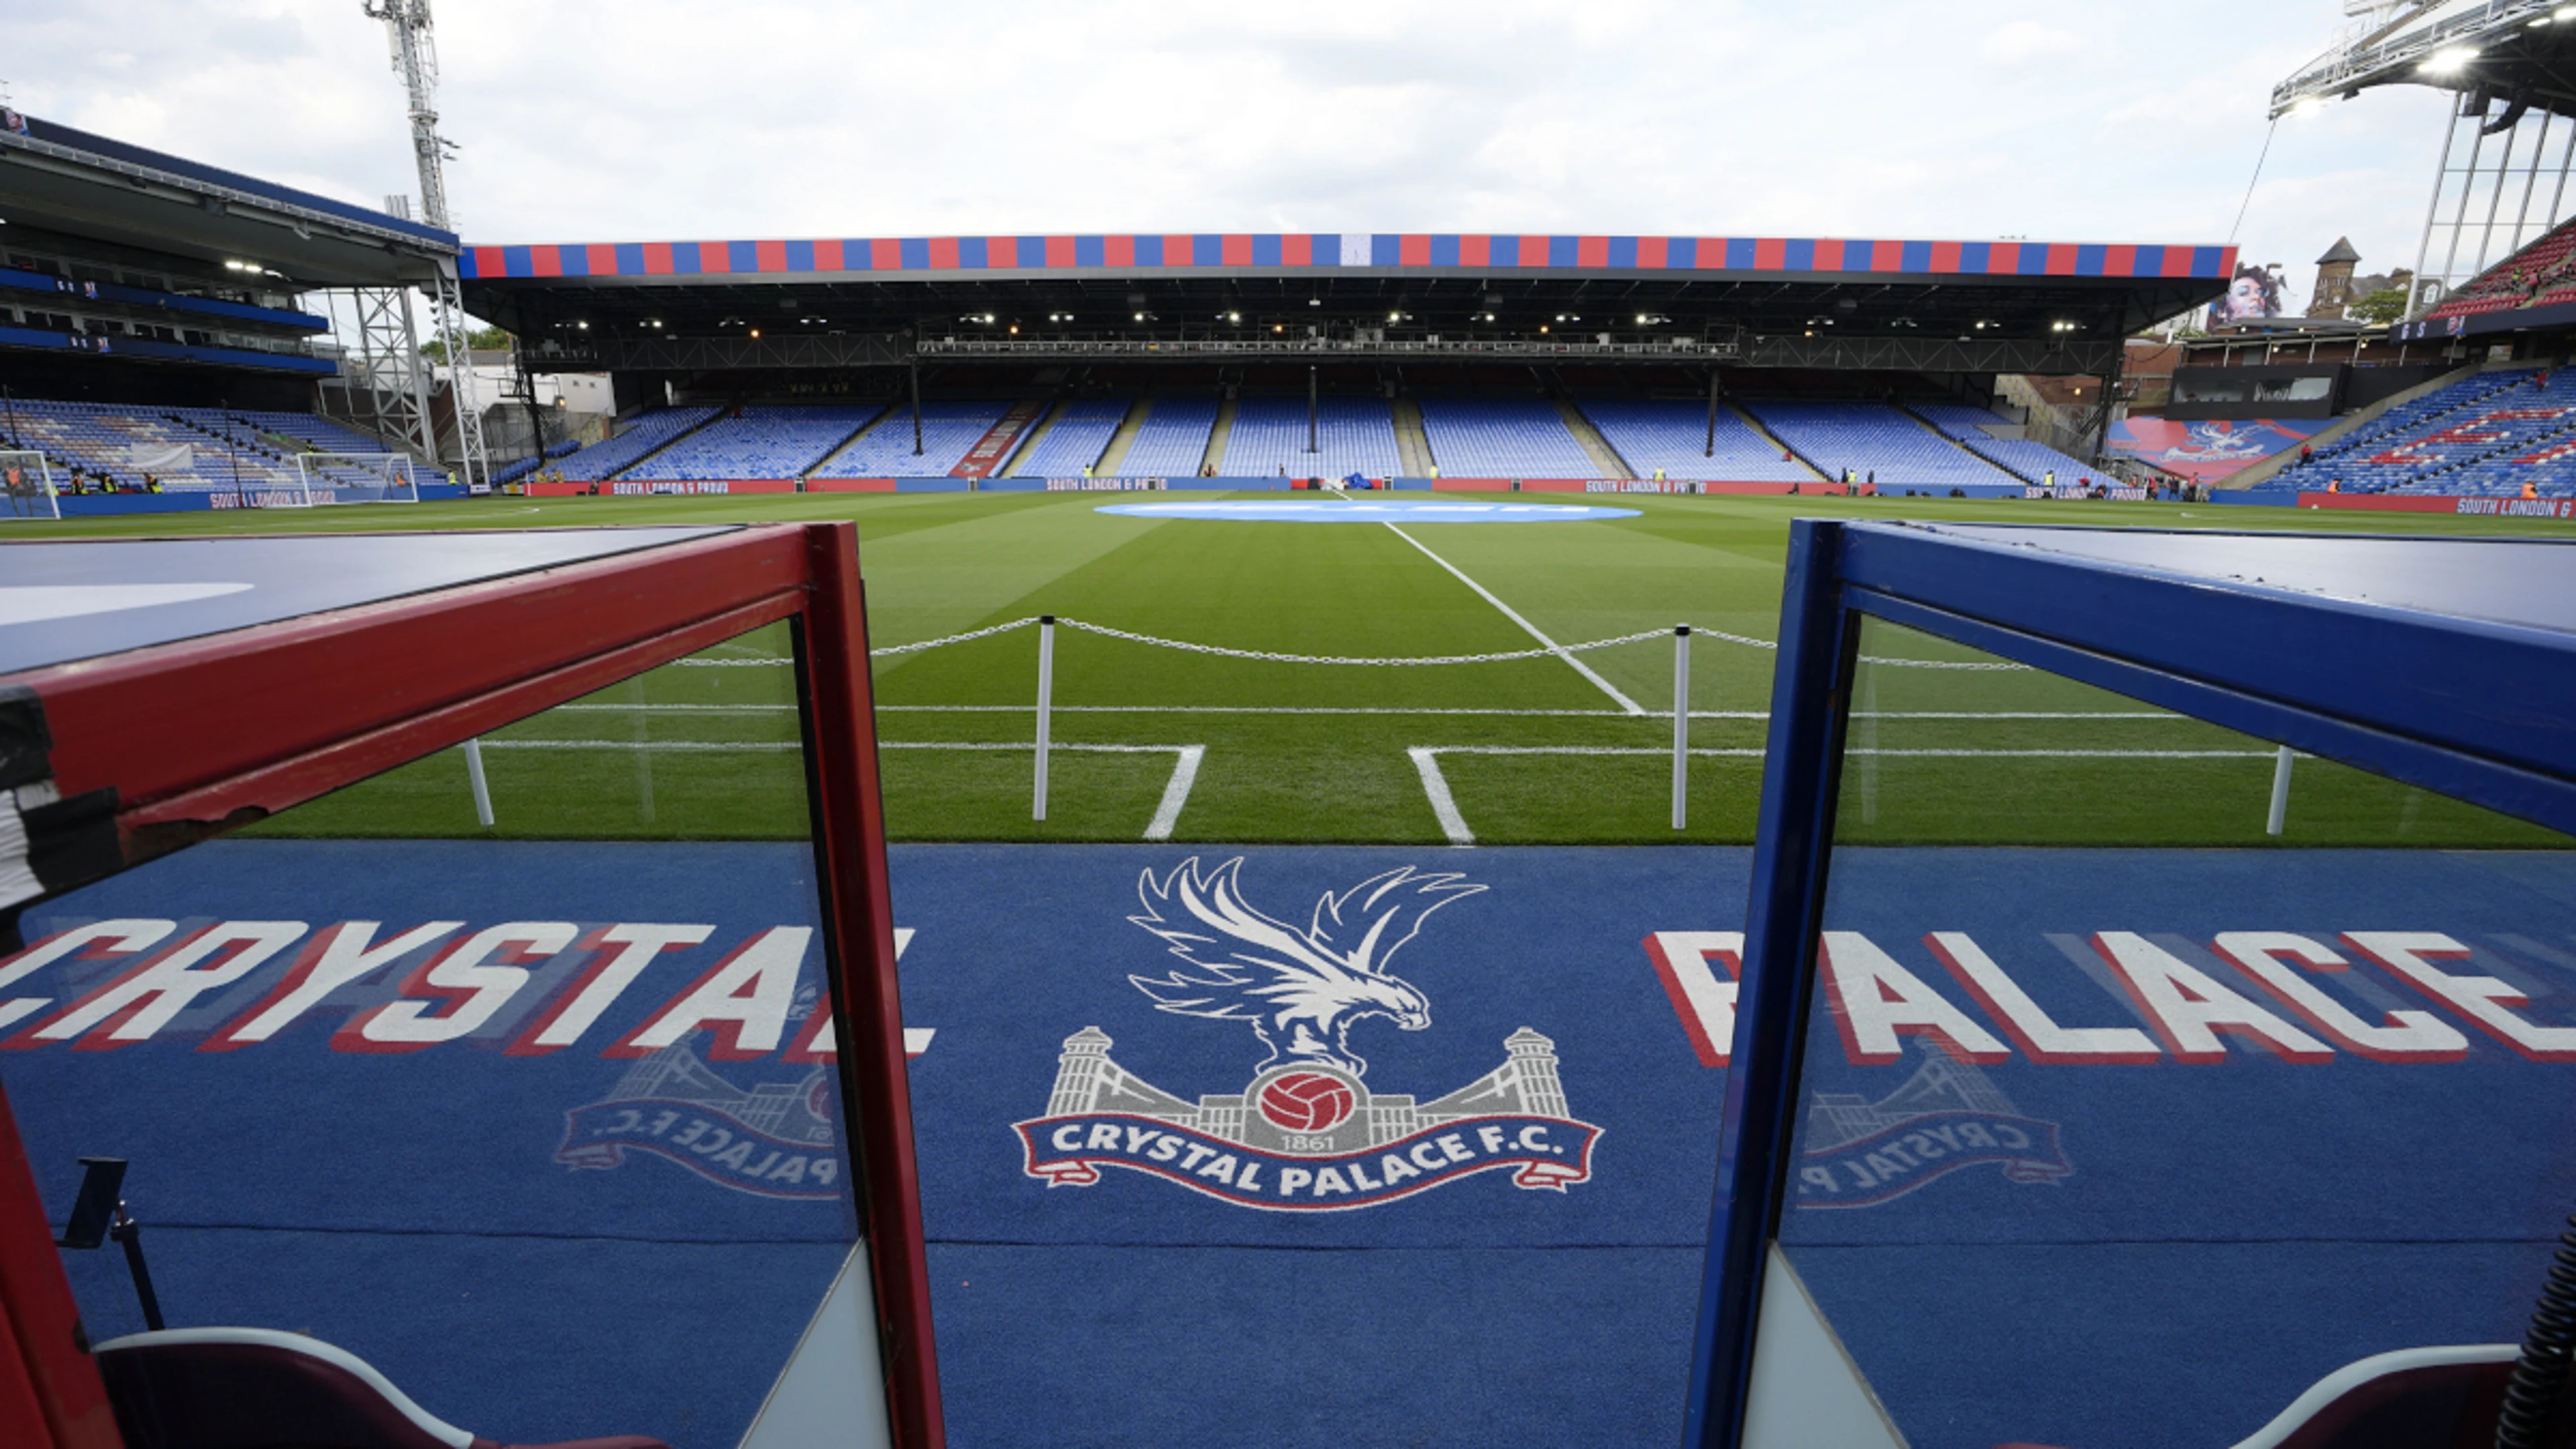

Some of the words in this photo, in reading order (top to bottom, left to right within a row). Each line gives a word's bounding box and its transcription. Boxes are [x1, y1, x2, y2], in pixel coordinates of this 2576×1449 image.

[613, 482, 644, 494] SOUTH
[1046, 478, 1078, 490] SOUTH
[1081, 478, 1121, 490] LONDON
[1620, 480, 1660, 493] LONDON
[2457, 498, 2498, 515] SOUTH
[2500, 500, 2557, 517] LONDON
[2559, 502, 2573, 519] &
[1281, 1135, 1334, 1151] 1861
[1052, 1122, 1262, 1191] CRYSTAL
[1279, 1133, 1476, 1196] PALACE
[1477, 1126, 1564, 1154] F.C.
